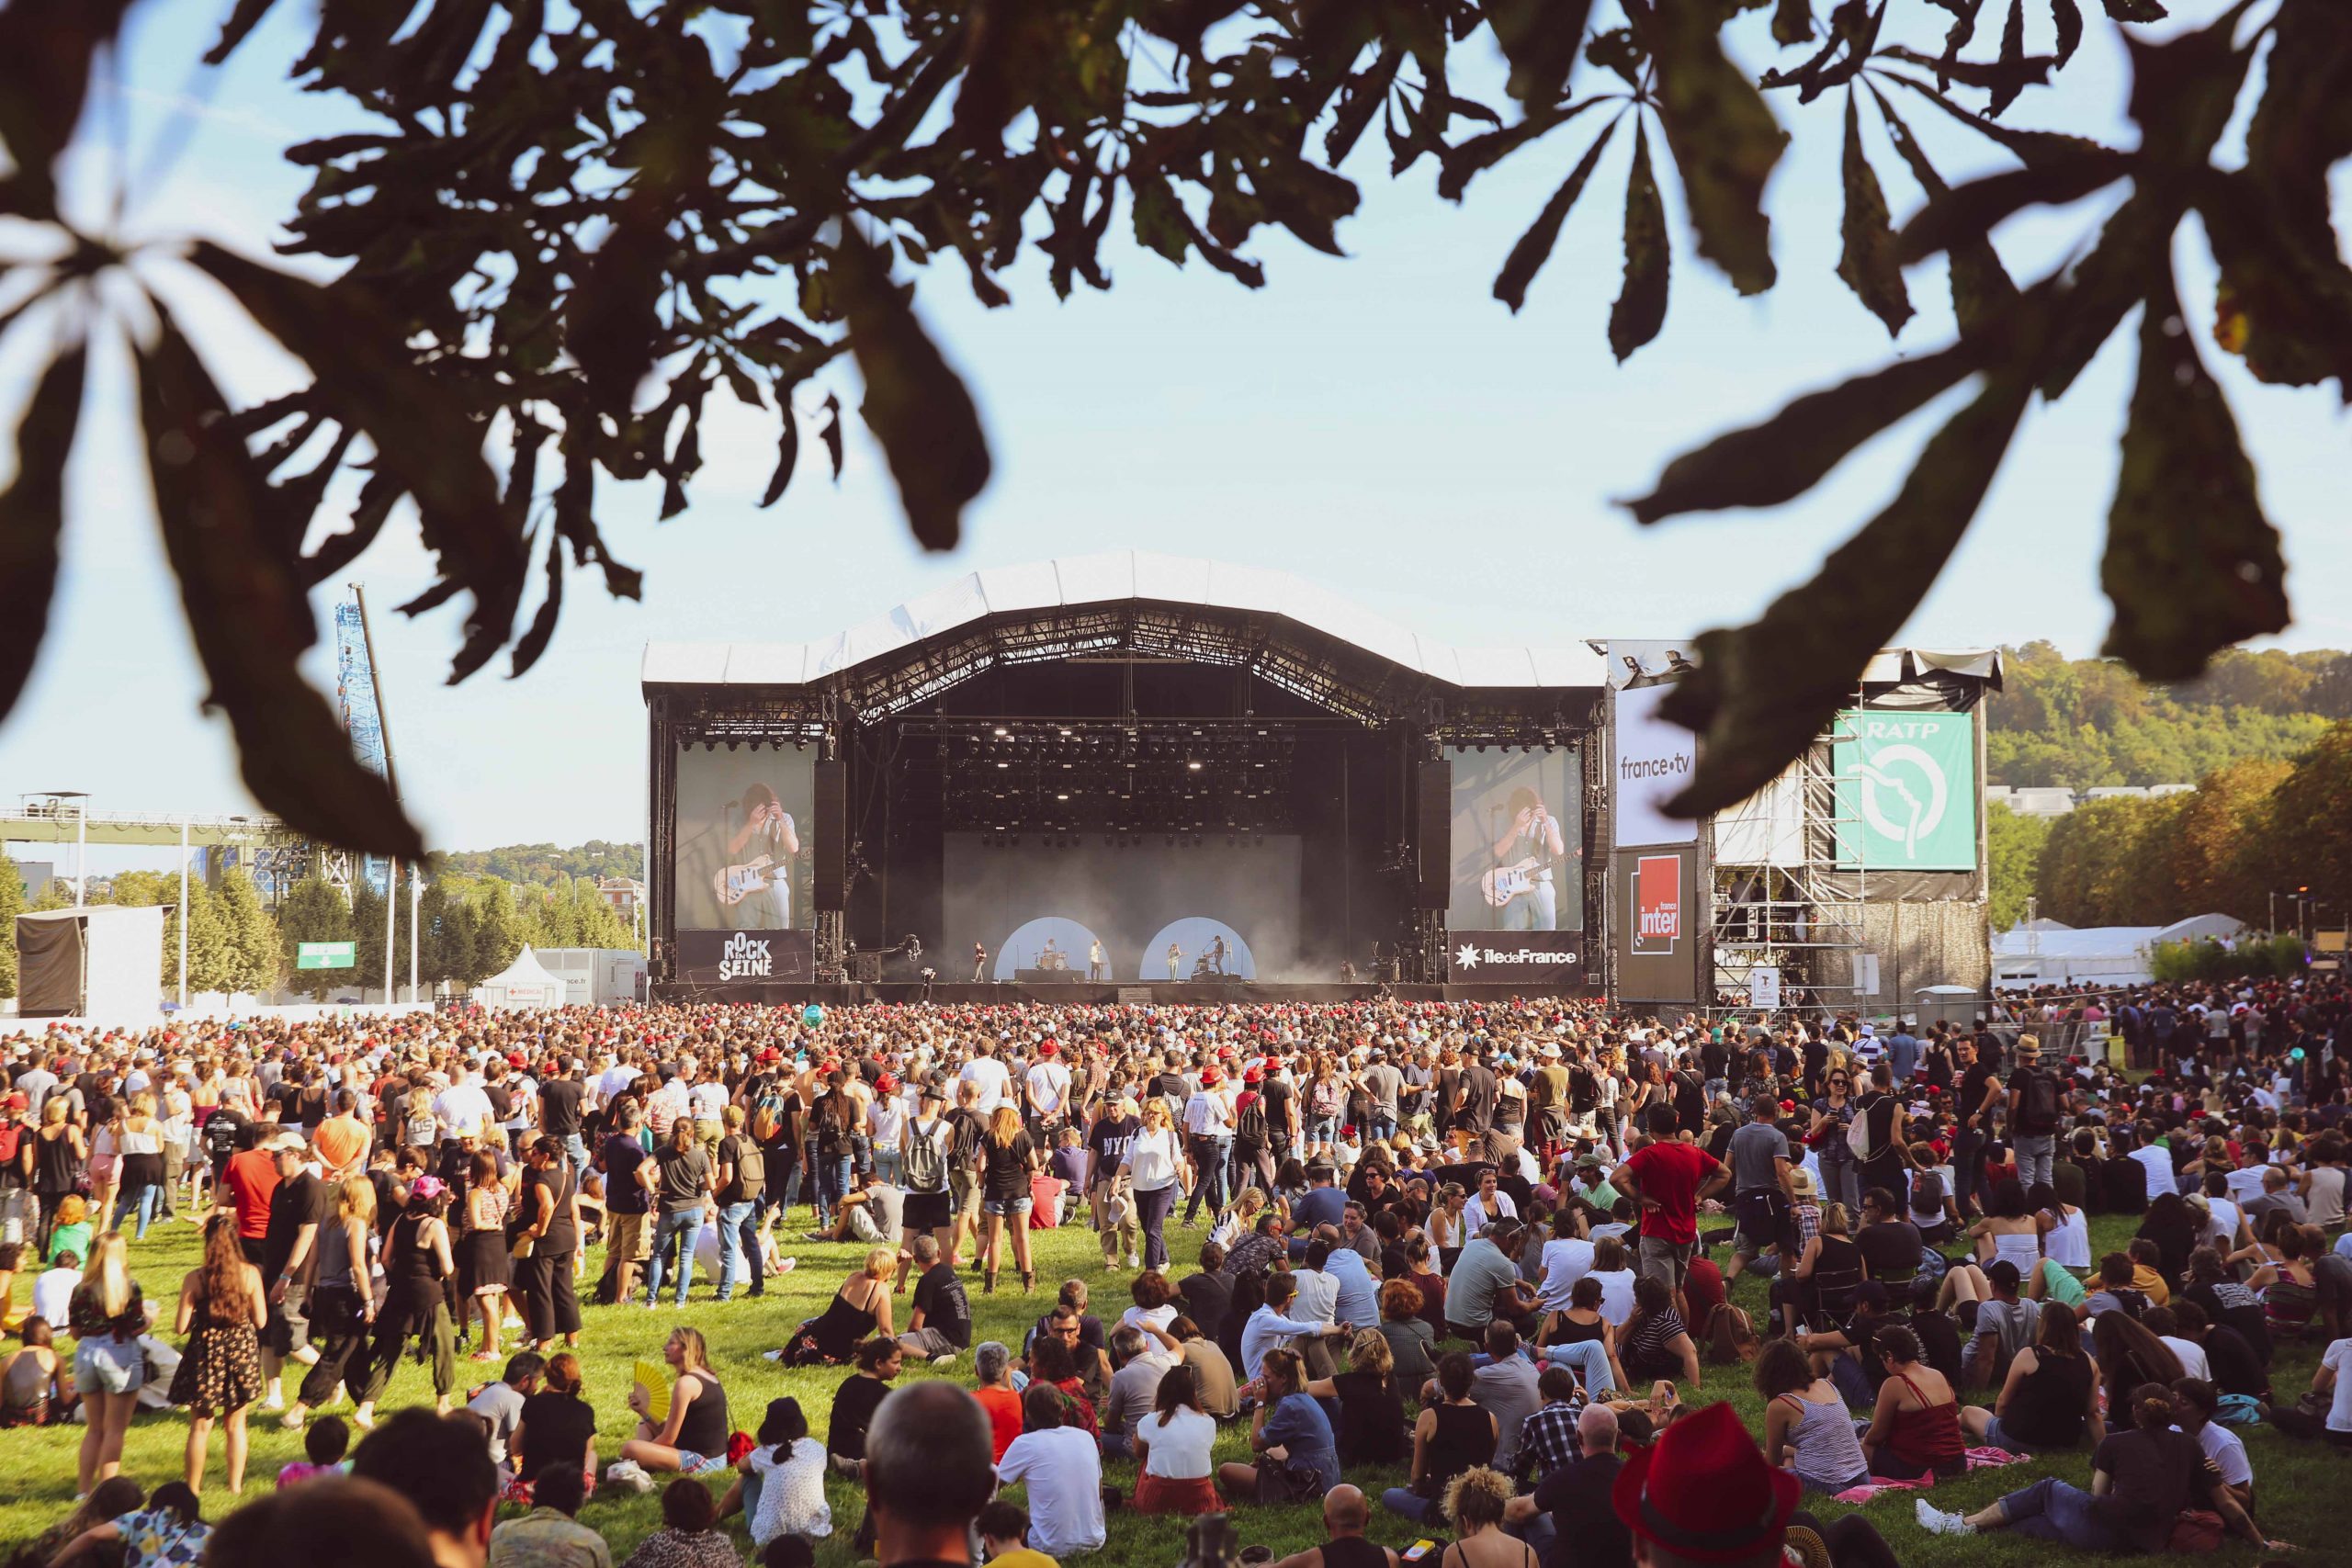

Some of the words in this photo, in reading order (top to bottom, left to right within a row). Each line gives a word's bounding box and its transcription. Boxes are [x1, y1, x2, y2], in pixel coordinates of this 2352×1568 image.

[1867, 722, 1940, 739] RATP
[1641, 906, 1677, 934] inter
[724, 931, 773, 960] ROCK
[735, 952, 745, 960] EN
[718, 959, 773, 981] SEINE
